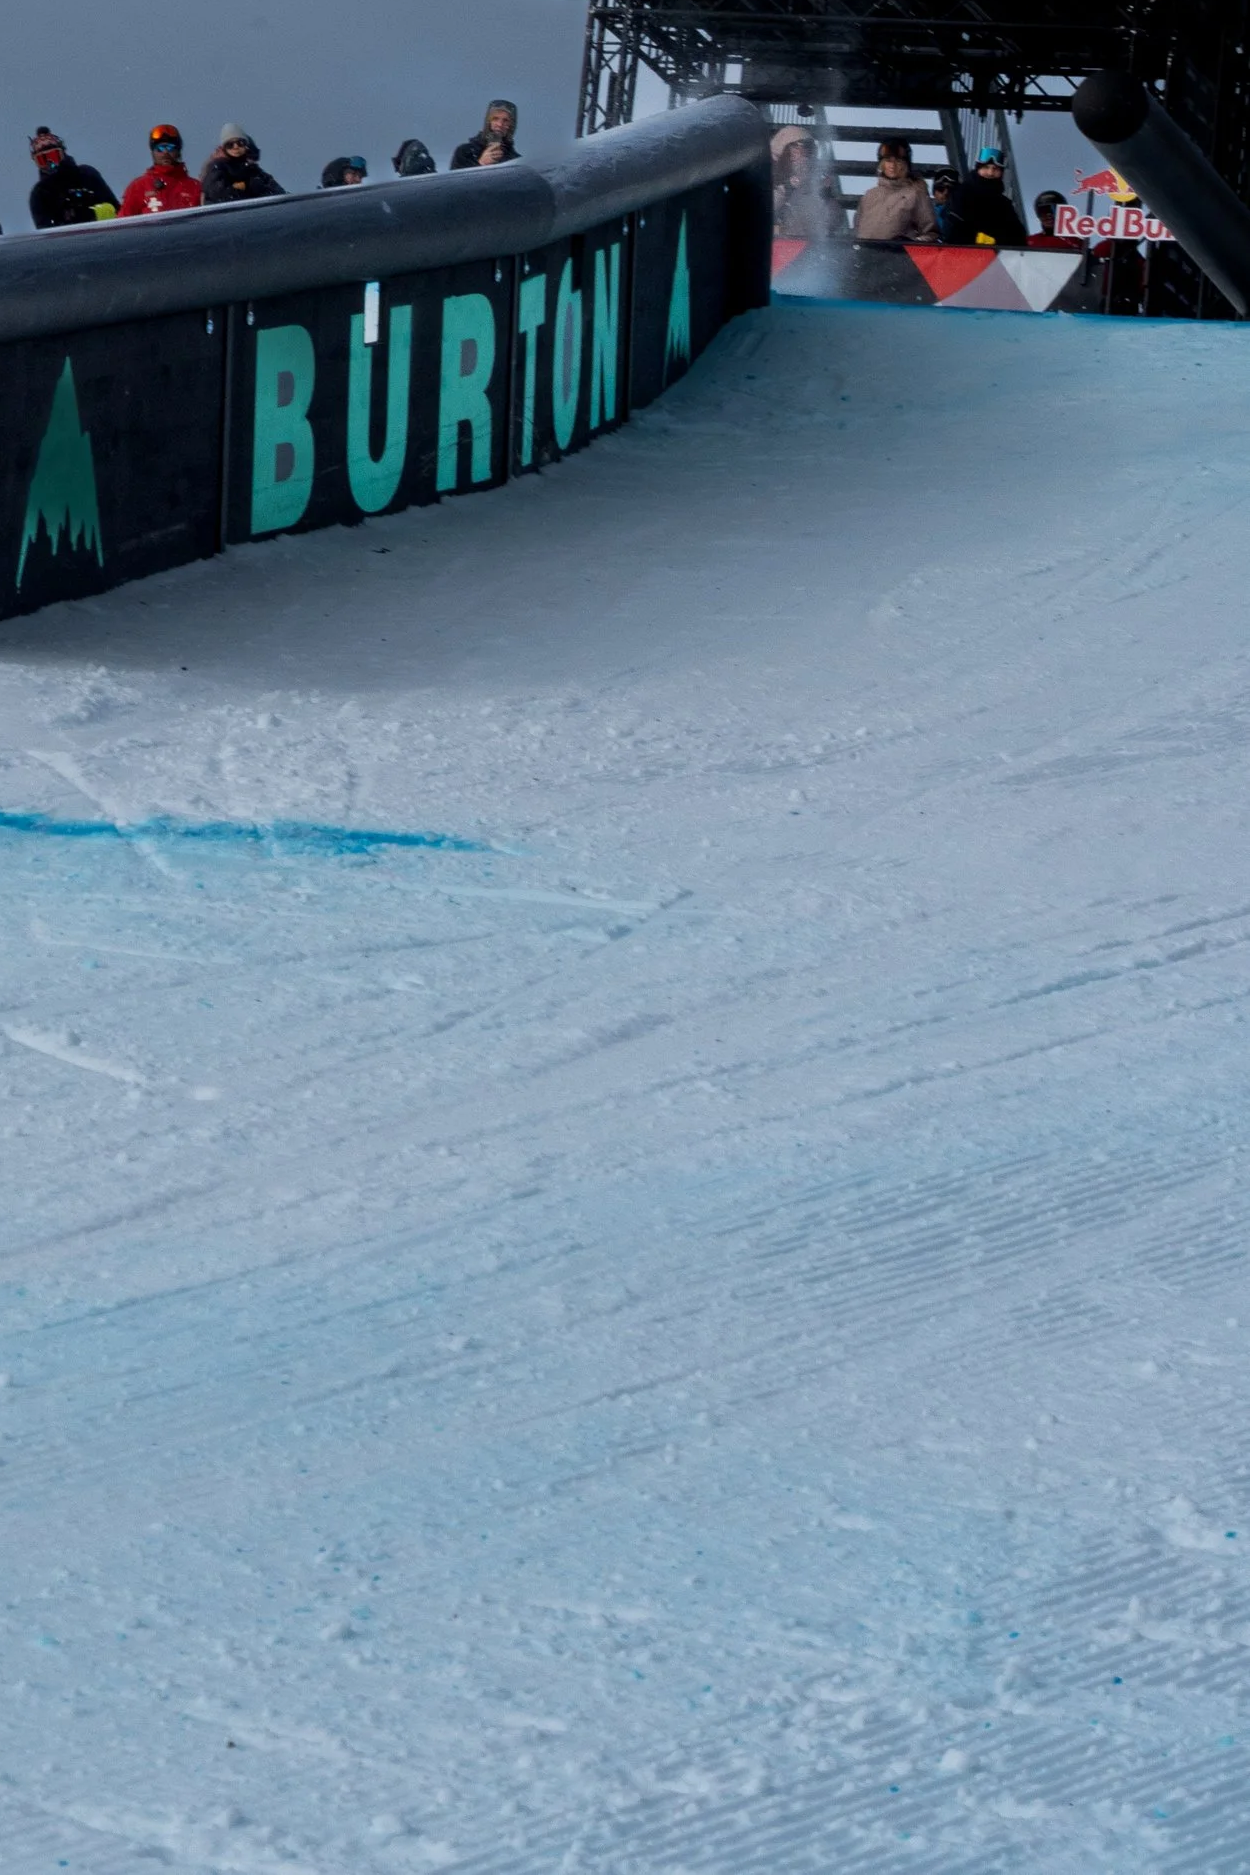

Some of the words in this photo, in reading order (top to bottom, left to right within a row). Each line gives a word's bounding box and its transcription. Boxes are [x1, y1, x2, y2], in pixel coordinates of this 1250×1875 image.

[1057, 206, 1119, 237] Red
[1122, 208, 1174, 239] Bu
[251, 242, 621, 535] BURTON
